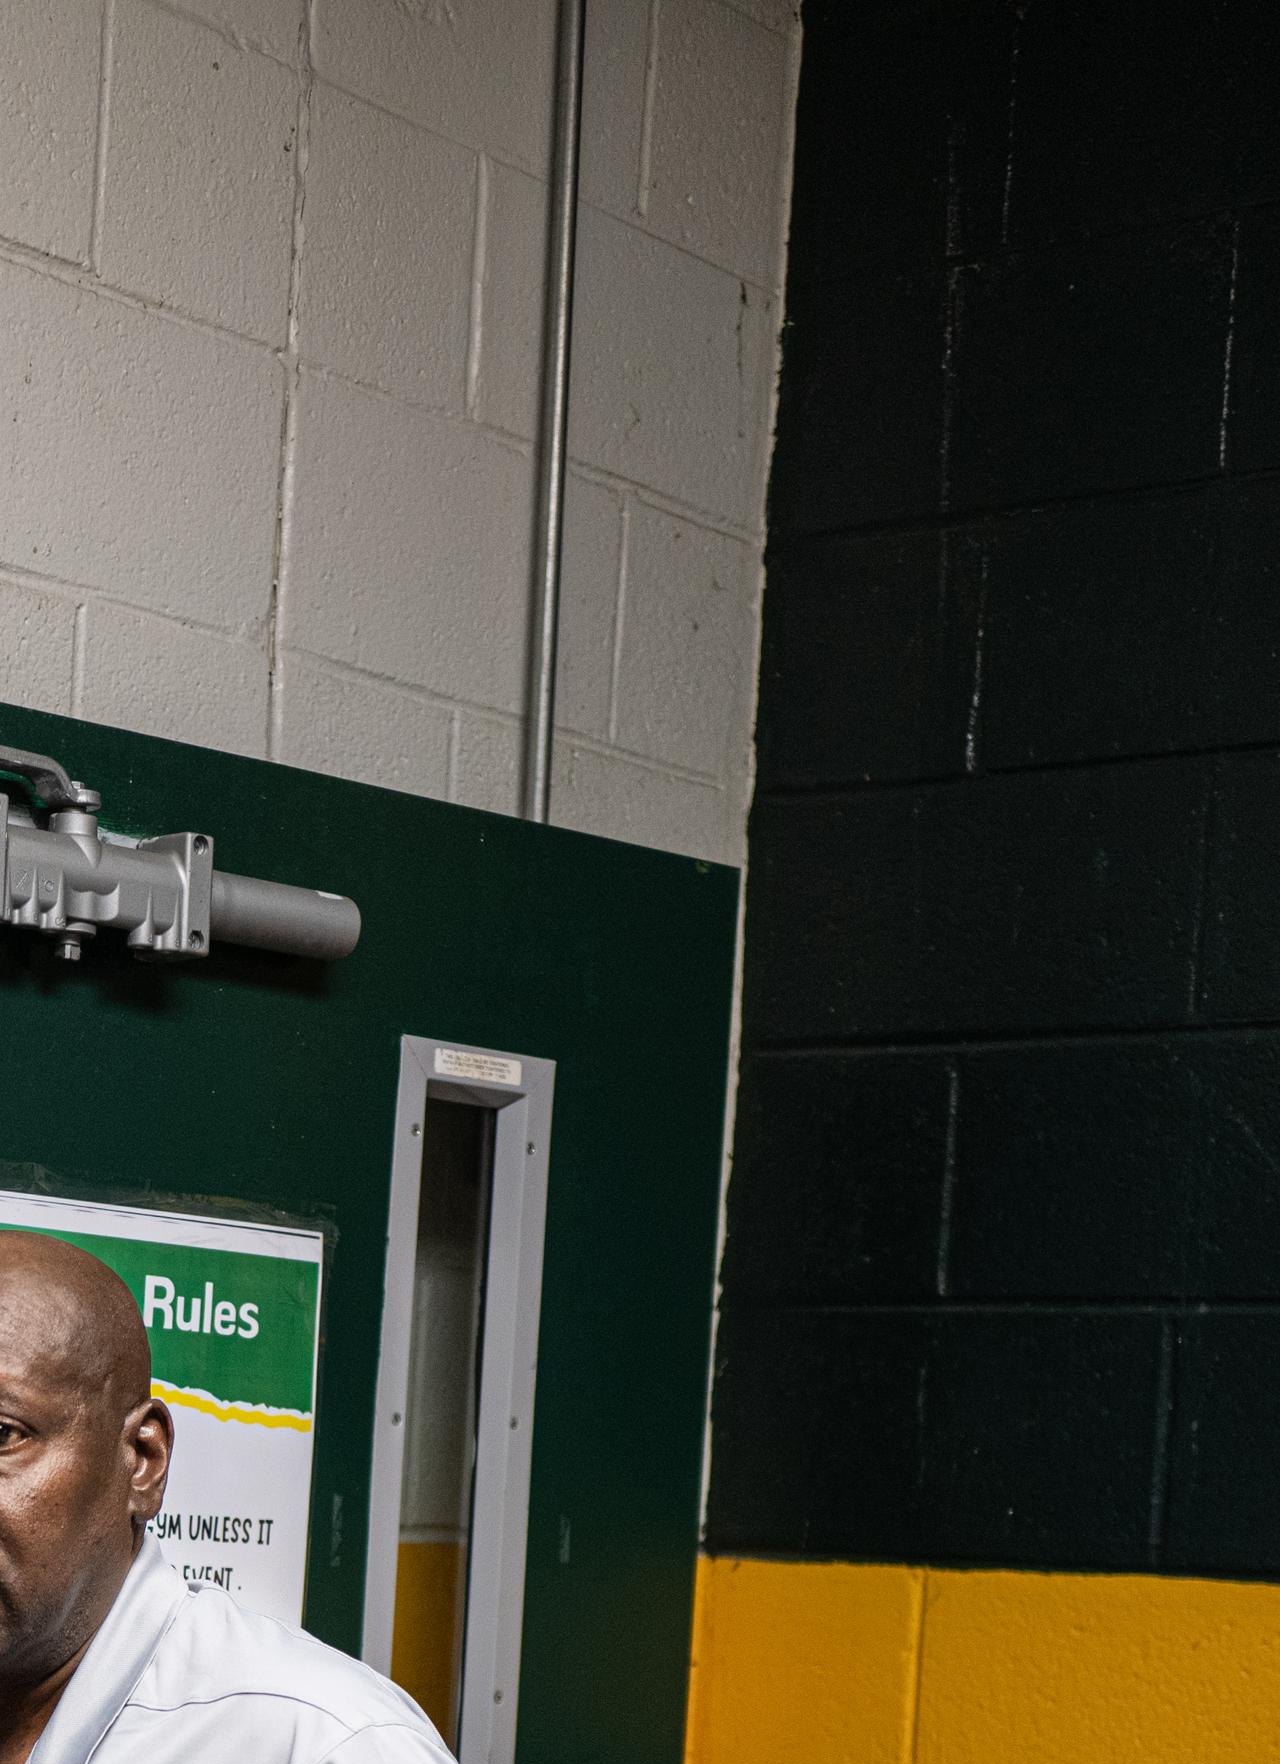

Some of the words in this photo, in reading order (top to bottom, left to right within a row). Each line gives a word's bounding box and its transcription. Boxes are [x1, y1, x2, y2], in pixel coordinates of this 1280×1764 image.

[144, 1274, 260, 1340] Rules
[147, 1513, 182, 1540] YM
[190, 1515, 252, 1544] UNLESS
[257, 1519, 274, 1546] IT
